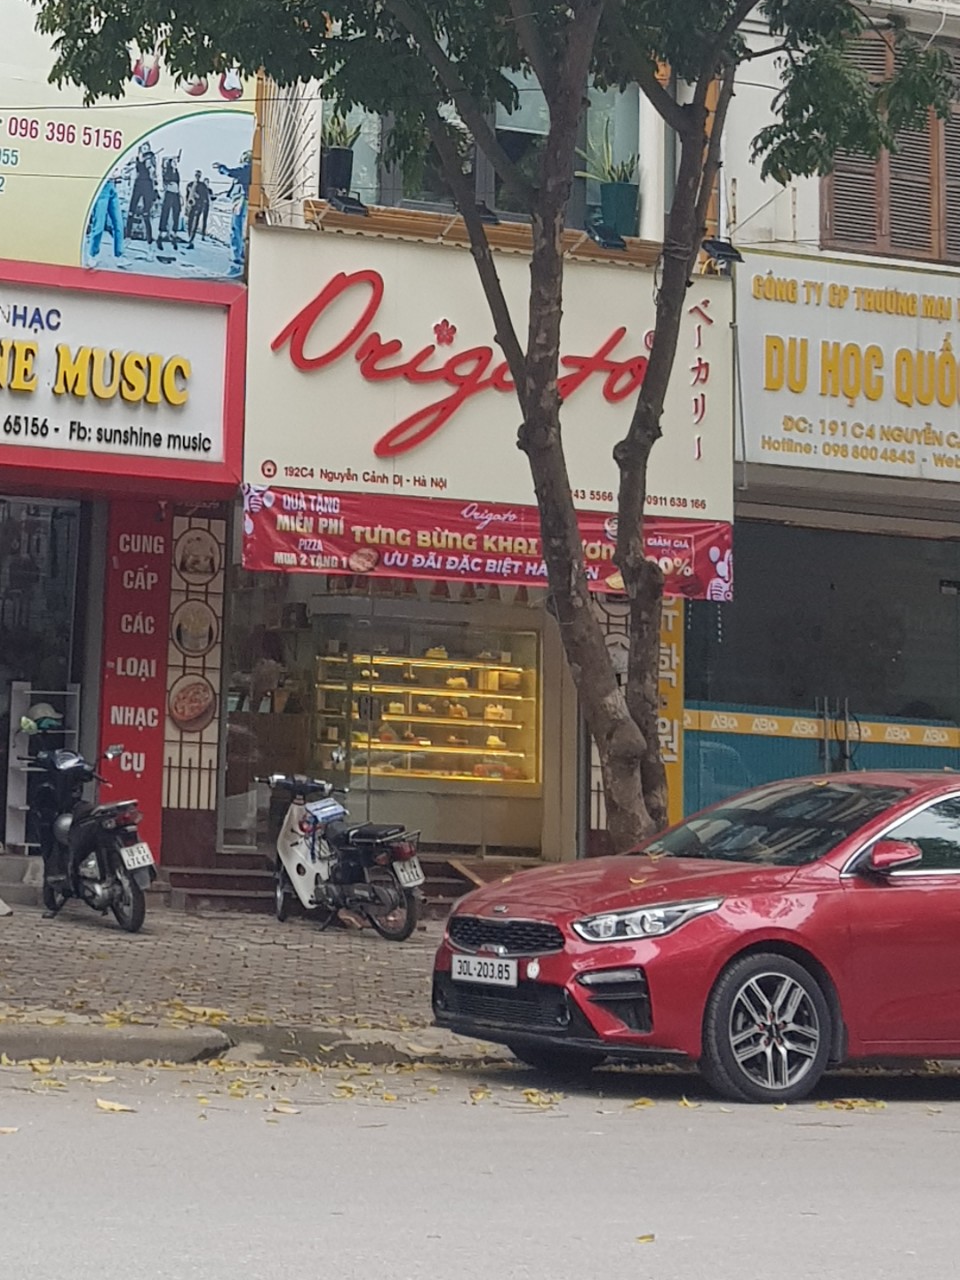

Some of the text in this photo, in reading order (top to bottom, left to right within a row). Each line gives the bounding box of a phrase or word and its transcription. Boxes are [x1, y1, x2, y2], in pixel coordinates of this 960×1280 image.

[7, 116, 123, 150] 096 396 5156
[802, 279, 825, 307] TY
[852, 286, 919, 318] THƯƠNG
[920, 294, 953, 324] MẠI
[52, 342, 193, 407] MUSIC
[764, 331, 960, 409] DU HỌC QUỐ
[3, 414, 49, 437] 65156
[68, 421, 92, 442] Fb:
[96, 427, 163, 449] sunshine
[167, 432, 213, 453] music
[782, 415, 814, 435] ĐC:
[819, 418, 848, 439] 191
[850, 422, 876, 441] C4
[880, 421, 945, 448] NGUYỄN
[760, 434, 819, 456] Hotline:
[821, 441, 850, 458] 098
[850, 443, 879, 462] 800
[879, 446, 916, 465] 4843
[283, 466, 315, 479] 192C4
[319, 467, 359, 484] Nguyễn
[362, 471, 389, 485] Cảnh
[392, 475, 404, 488] Dị
[413, 475, 427, 488] Hà
[430, 476, 448, 490] Nội
[282, 491, 307, 511] QUÀ
[589, 490, 614, 503] 5566
[646, 495, 707, 511] 0911 638 166
[318, 516, 345, 536] PHÍ
[460, 502, 518, 531] Origato
[118, 533, 165, 555] CUNG
[298, 538, 324, 553] PIZZA
[482, 534, 539, 555] KHAI
[274, 551, 298, 566] MUA
[299, 554, 307, 566] 2
[341, 556, 348, 569] 1
[383, 550, 409, 567] ƯU
[412, 552, 442, 570] ĐÃI
[446, 554, 481, 574] ĐẶC
[485, 557, 523, 578] BIỆT
[122, 564, 159, 591] CẤP
[120, 611, 156, 635] CÁC
[116, 656, 157, 682] LOẠI
[110, 705, 160, 732] NHẠC
[120, 751, 147, 779] CỤ
